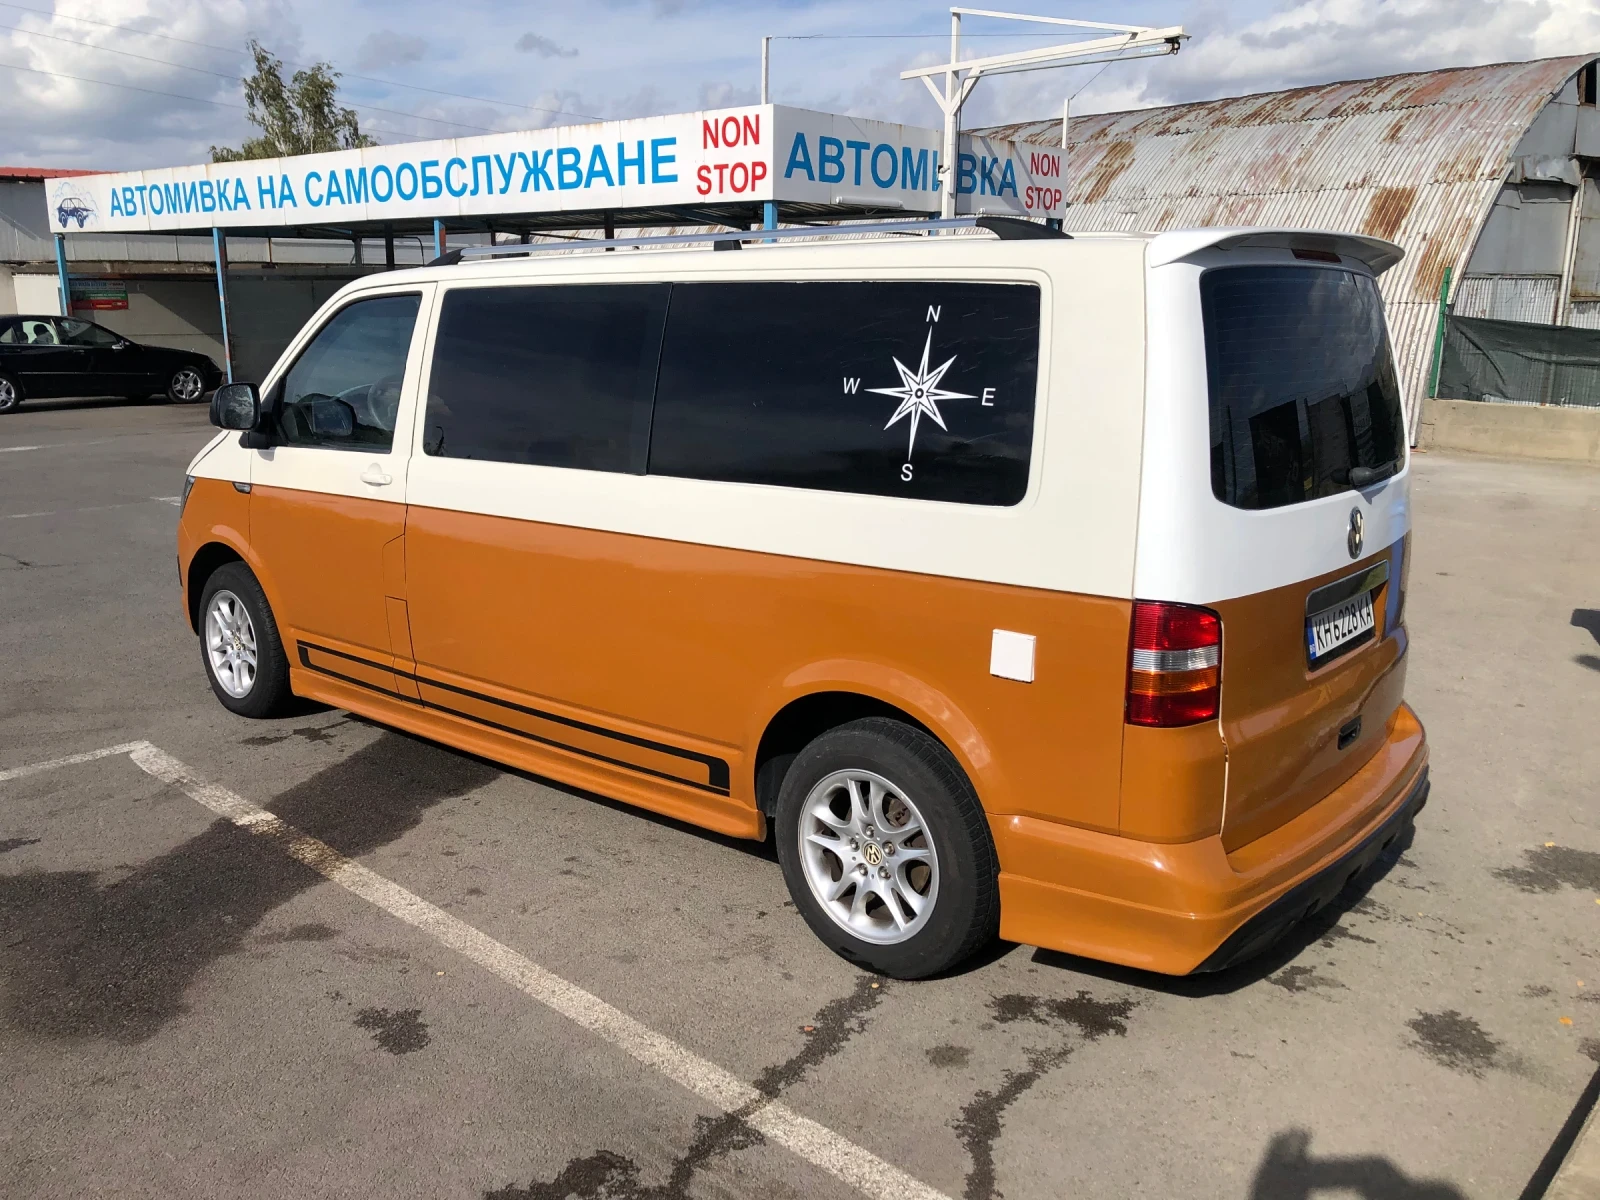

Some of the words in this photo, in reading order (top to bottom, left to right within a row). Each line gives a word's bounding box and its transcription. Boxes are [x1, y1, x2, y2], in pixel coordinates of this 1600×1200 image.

[703, 114, 760, 150] NON
[110, 177, 251, 217] АВТОМИВКА
[257, 173, 298, 209] НА
[304, 136, 679, 208] САМООБСЛУЖВАНЕ
[1030, 151, 1061, 178] NON
[696, 160, 768, 196] STOP
[1025, 185, 1063, 211] STOP
[925, 304, 941, 323] N
[843, 377, 861, 395] W
[981, 387, 996, 407] E
[900, 463, 914, 482] S
